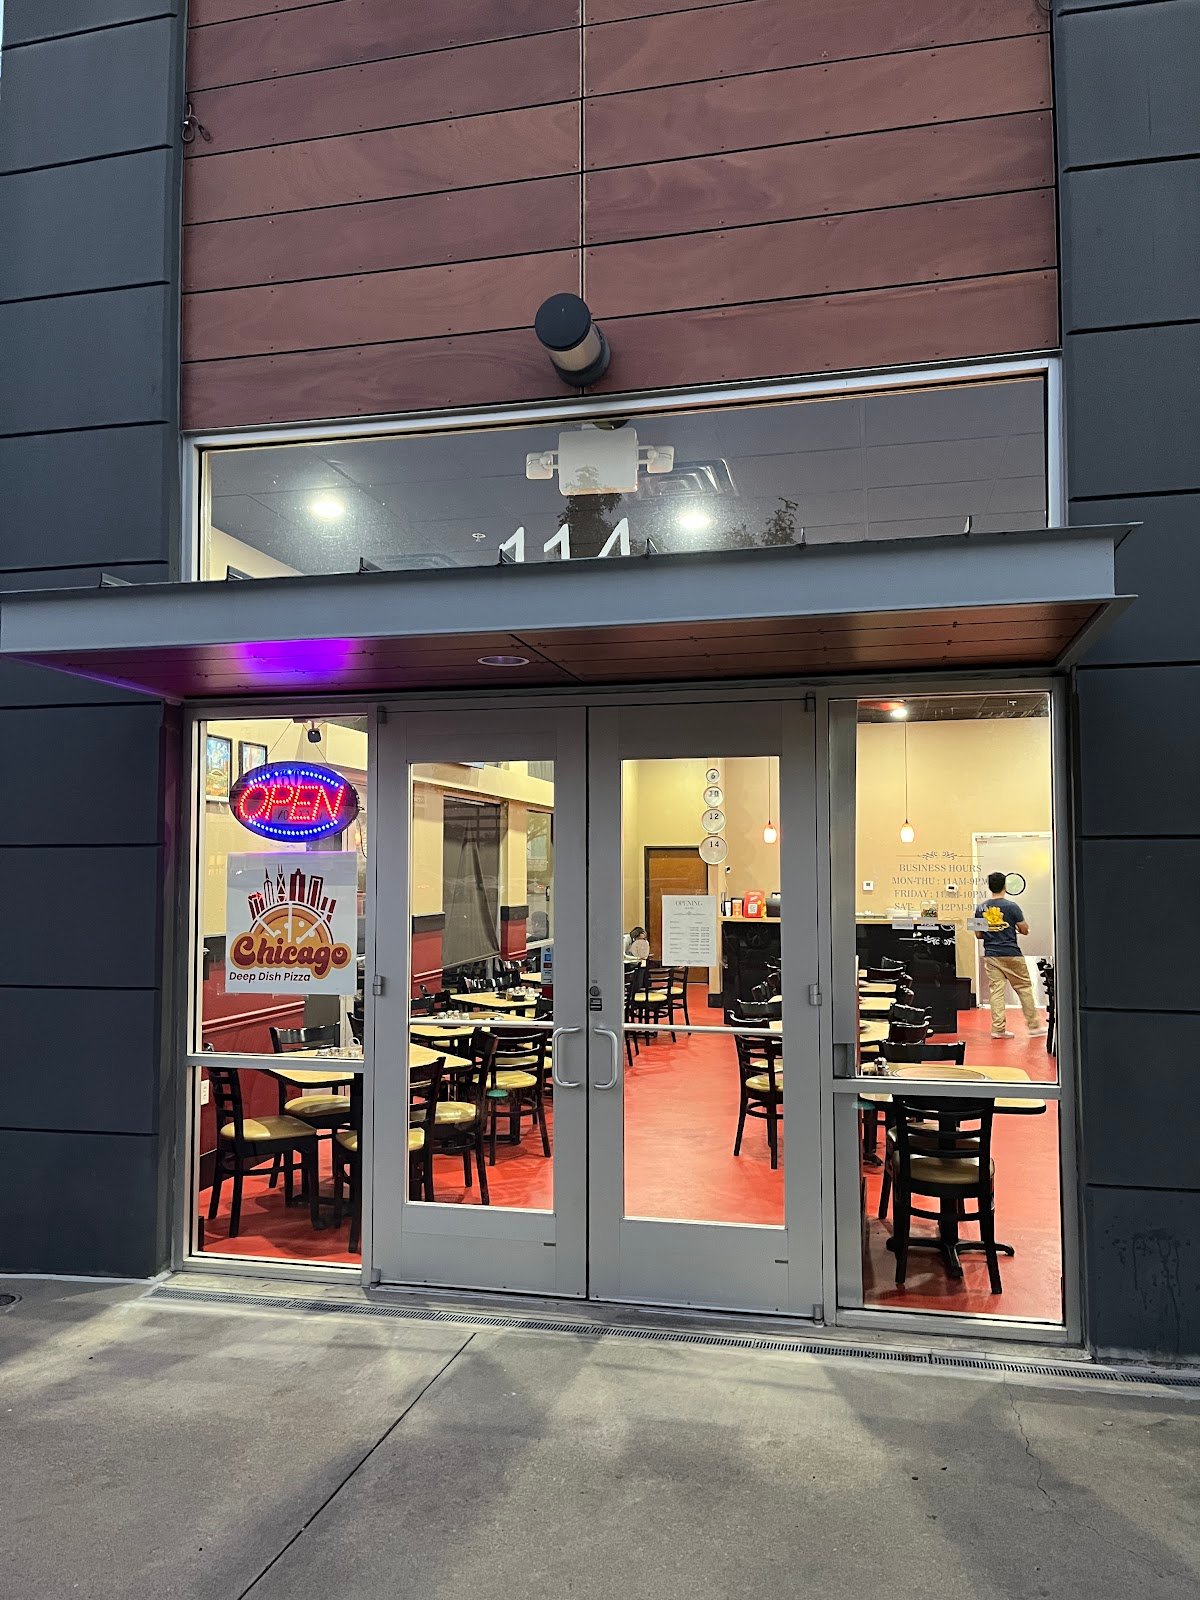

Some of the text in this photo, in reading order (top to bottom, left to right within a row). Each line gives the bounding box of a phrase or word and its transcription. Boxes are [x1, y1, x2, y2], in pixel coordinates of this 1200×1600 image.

[239, 783, 345, 821] OPEN
[709, 812, 719, 820] 12
[899, 863, 982, 873] BUSINESS HOURS
[891, 876, 935, 886] MON-THU
[894, 889, 929, 899] FRIDAY
[233, 935, 349, 976] Chicago
[229, 971, 311, 984] Deep Dish Pizza
